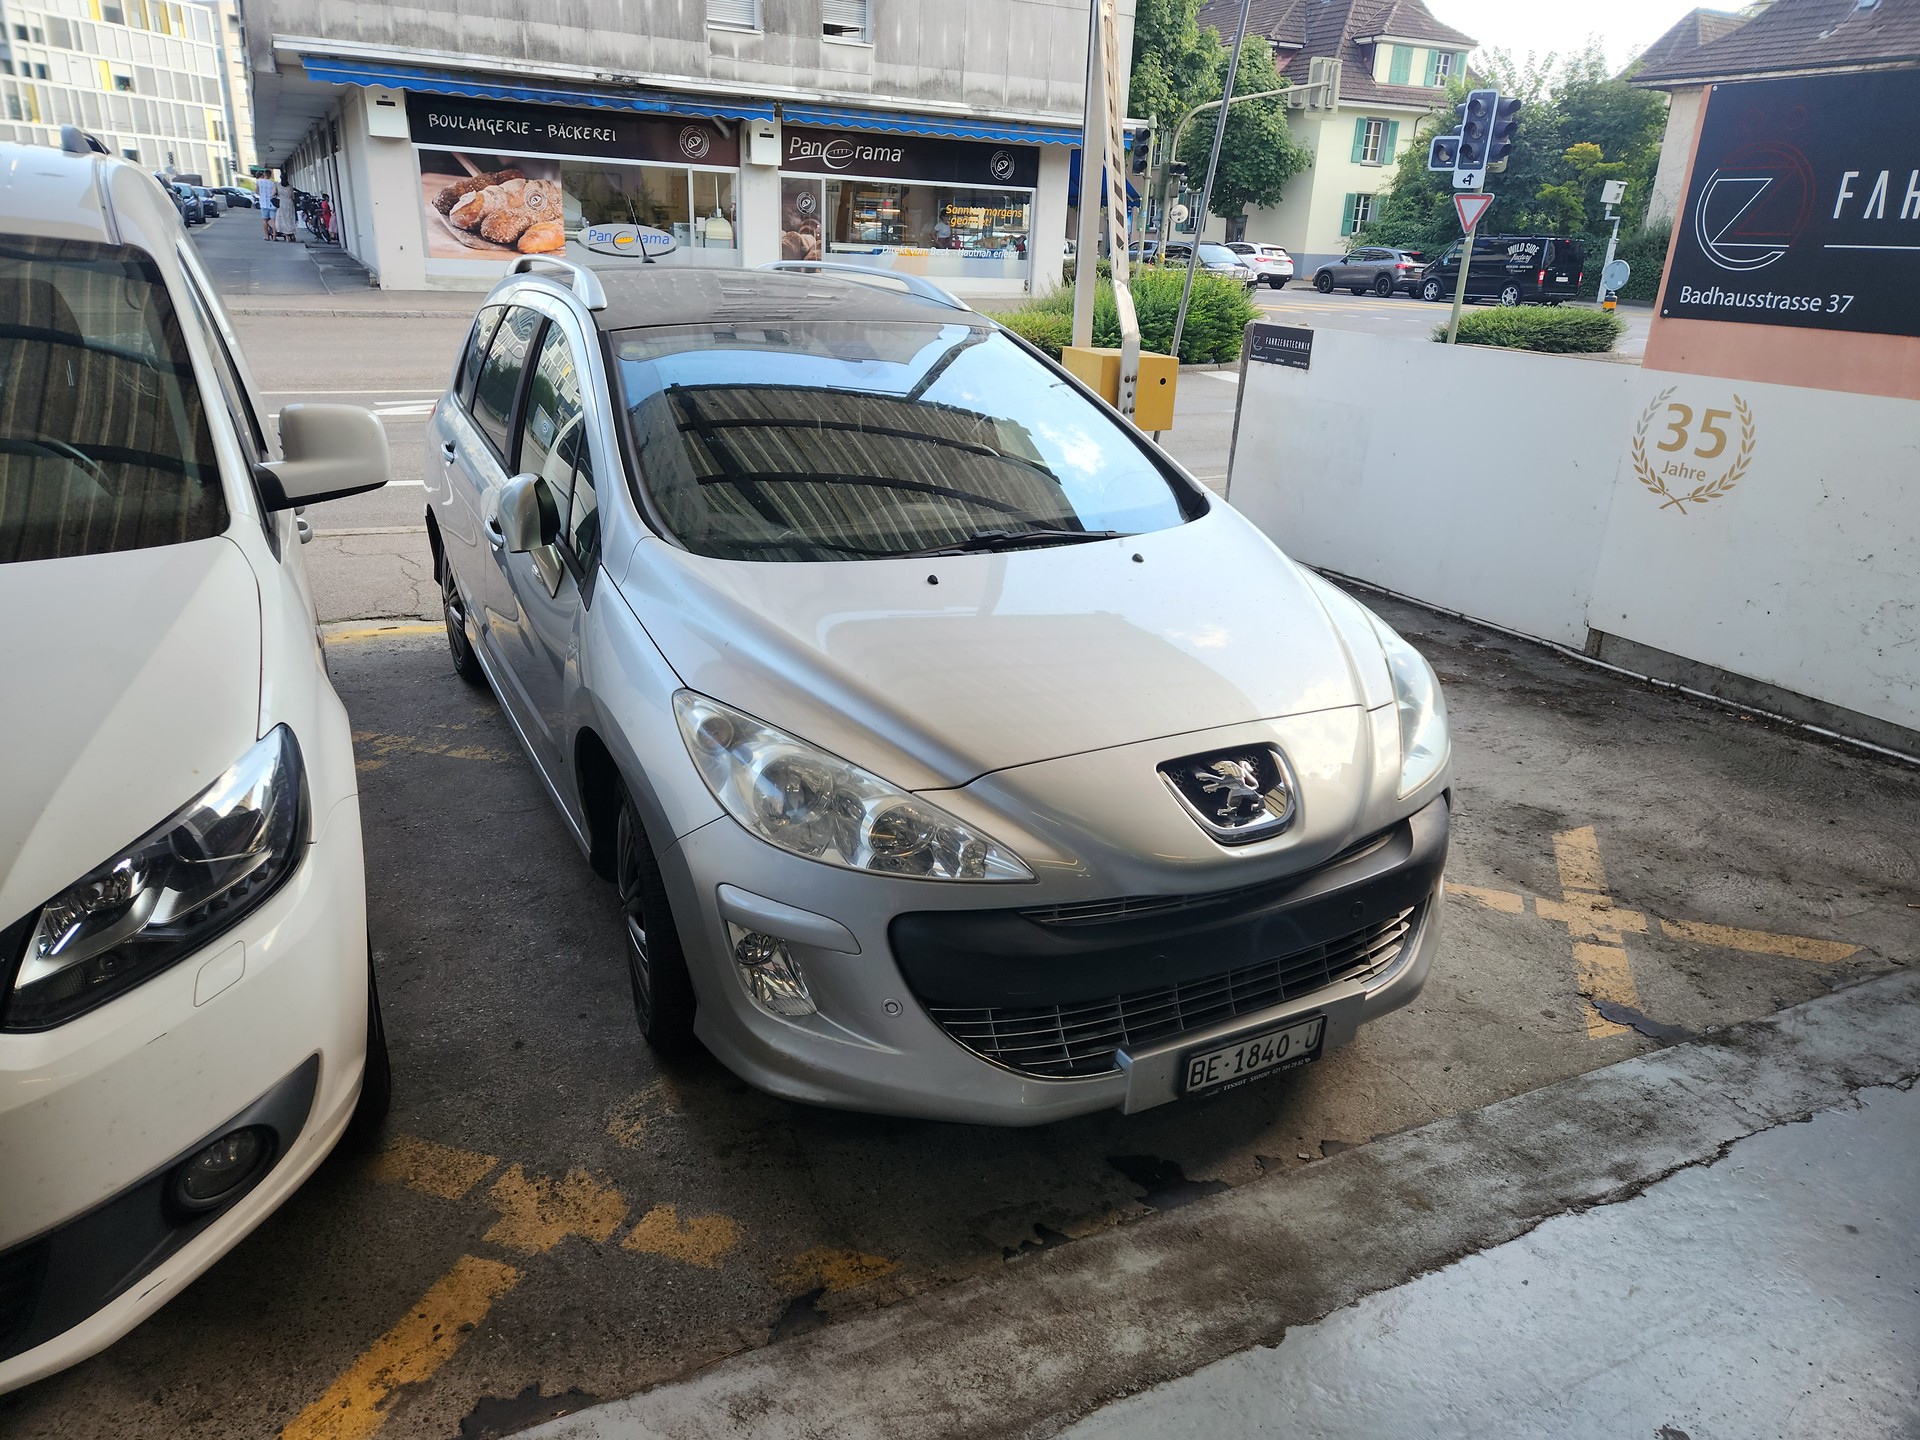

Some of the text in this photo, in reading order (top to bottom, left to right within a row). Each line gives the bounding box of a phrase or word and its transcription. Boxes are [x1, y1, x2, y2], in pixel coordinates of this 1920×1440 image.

[428, 113, 531, 136] BOULANGERIE
[548, 123, 617, 142] BÄCKEREI
[1507, 243, 1540, 256] WILD SIDE
[1680, 285, 1854, 314] Badhausstrasse 37
[1657, 403, 1733, 460] 35
[1662, 459, 1706, 482] Jahre
